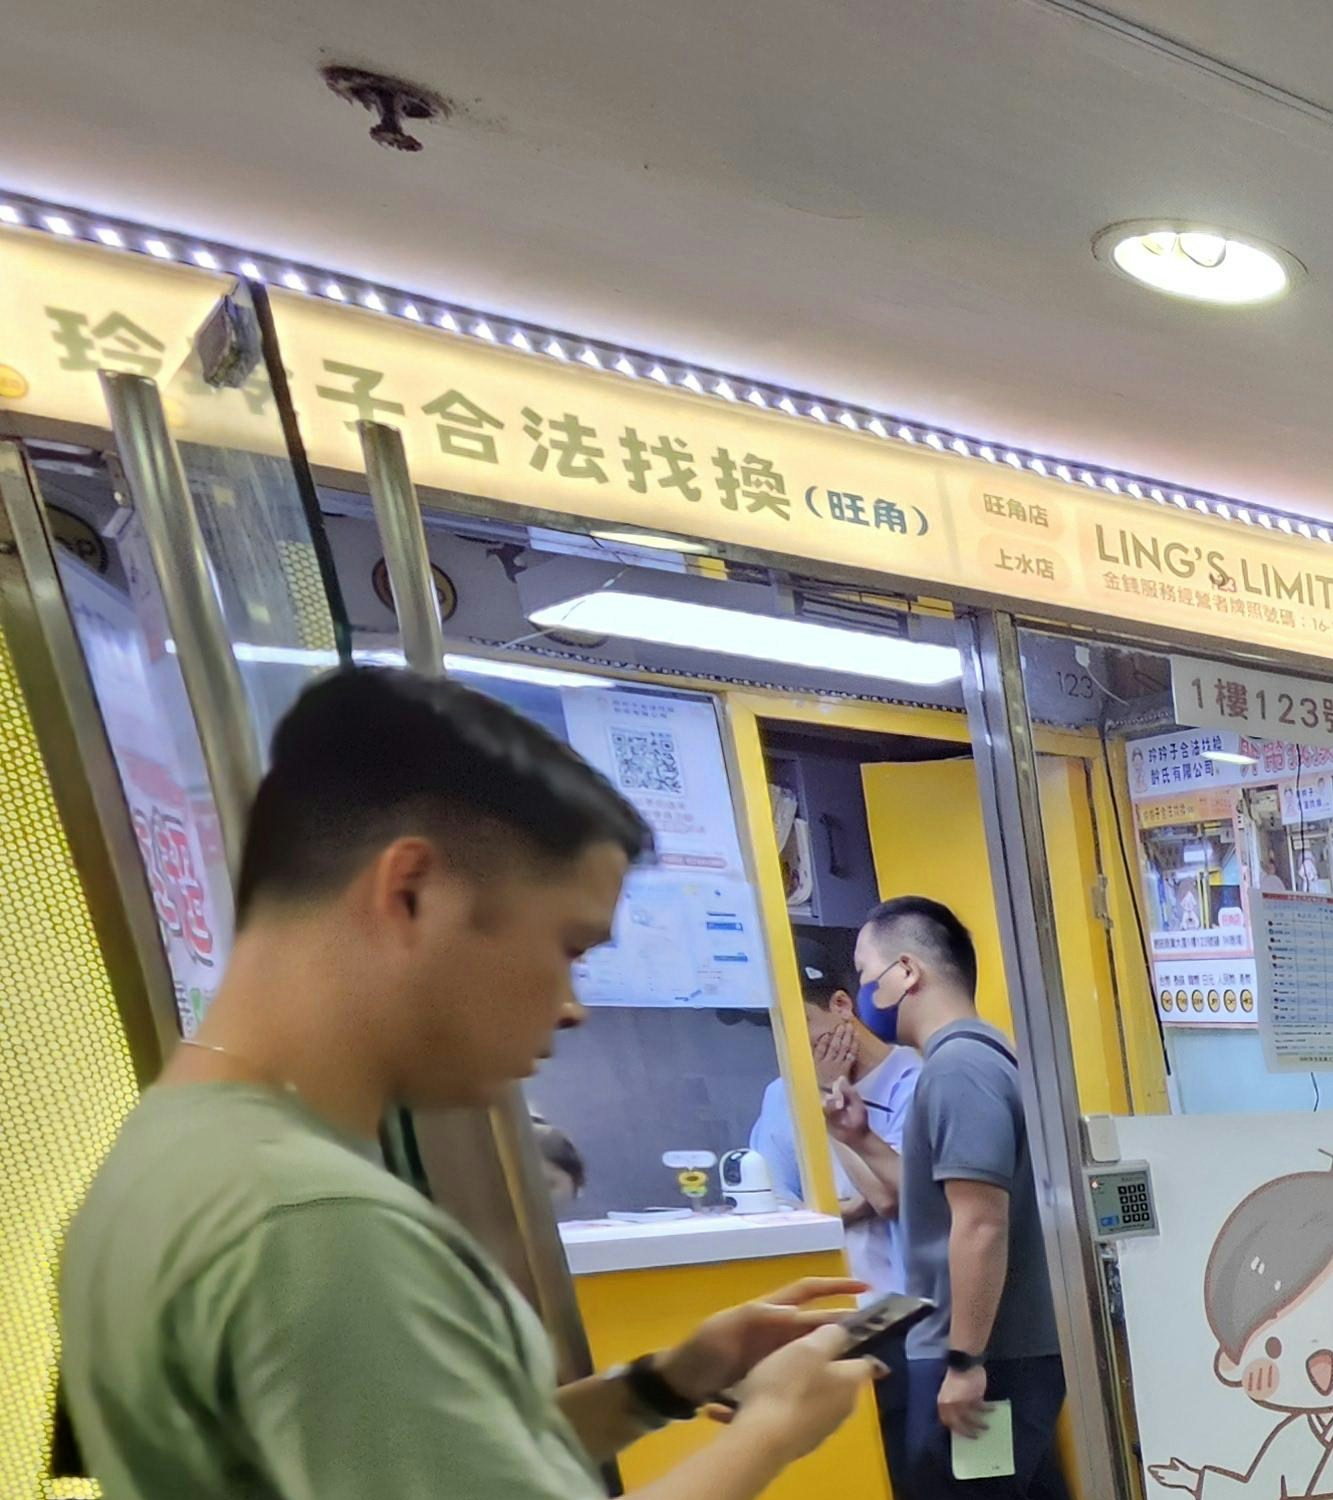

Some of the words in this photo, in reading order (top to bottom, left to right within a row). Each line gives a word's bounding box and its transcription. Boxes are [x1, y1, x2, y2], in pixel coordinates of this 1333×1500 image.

[983, 493, 1050, 528] 旺角店
[994, 547, 1056, 581] 上水店
[1057, 671, 1095, 700] 123
